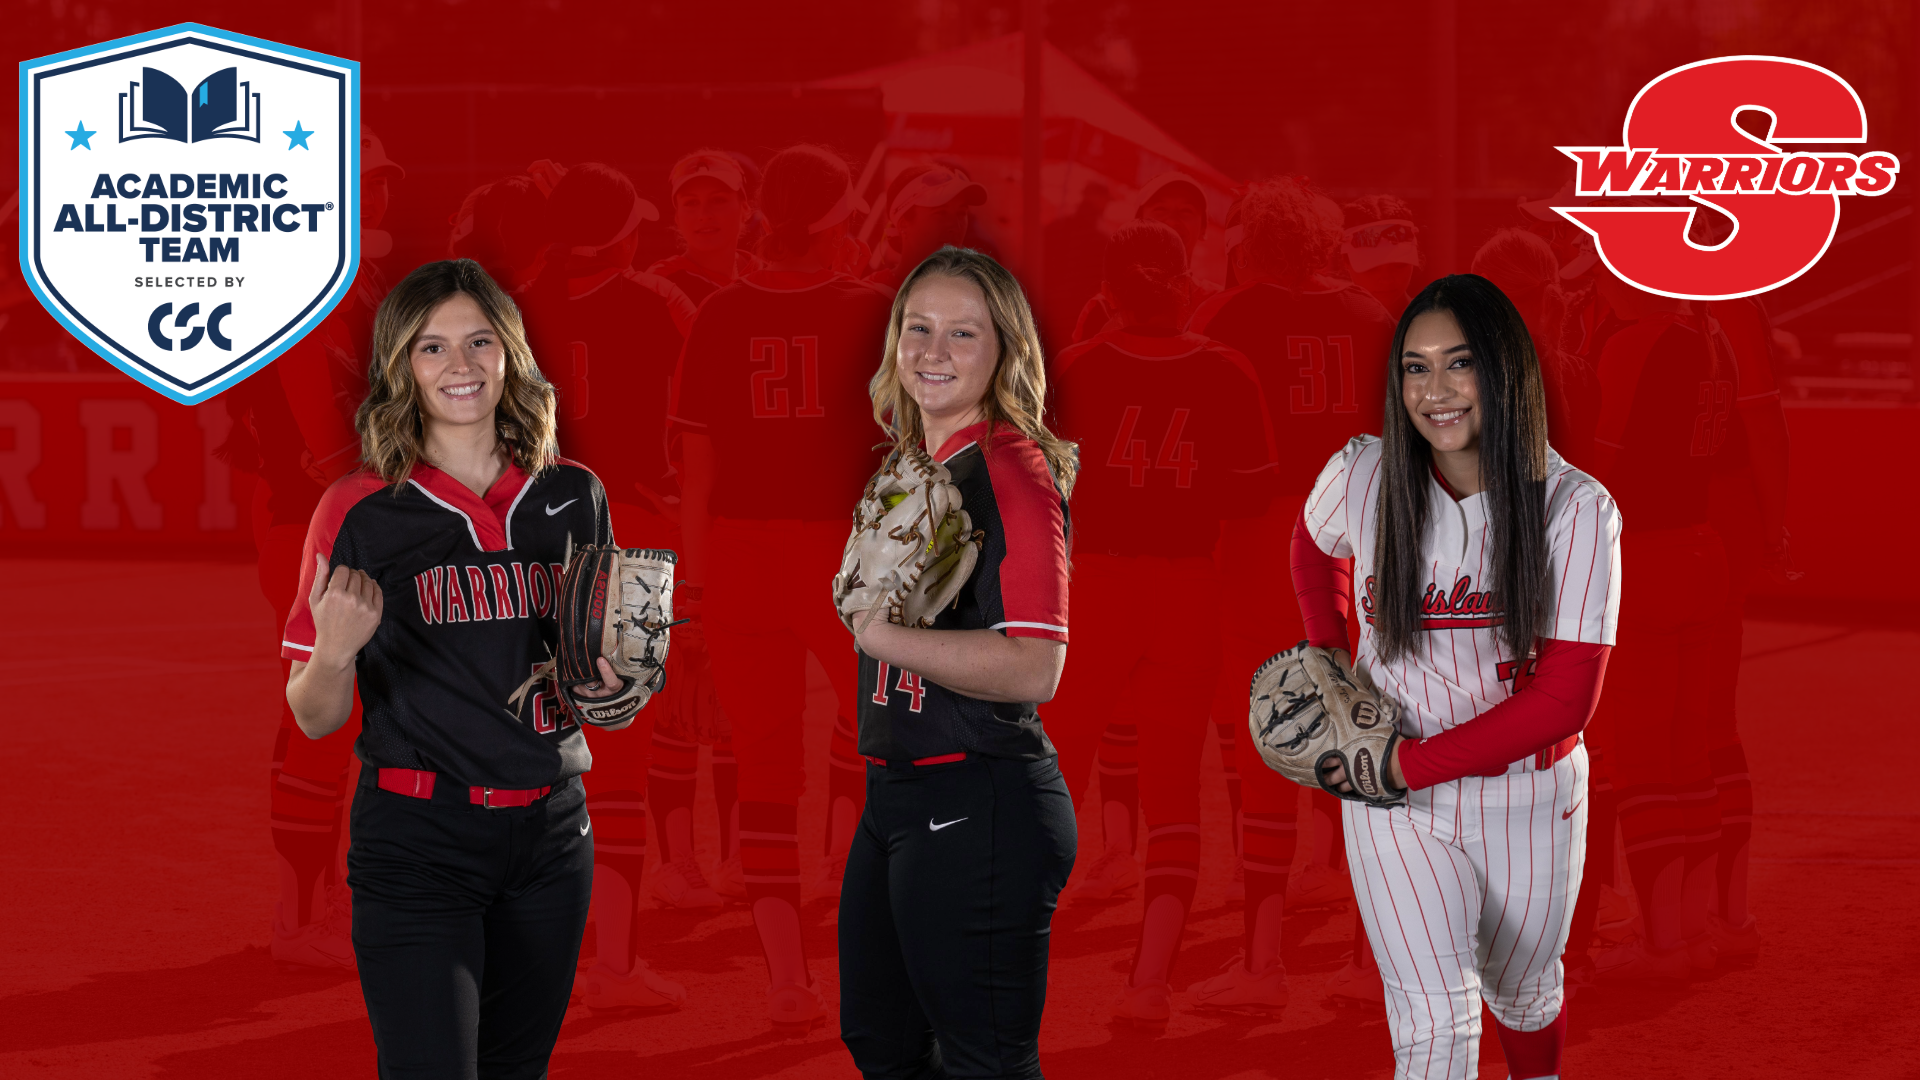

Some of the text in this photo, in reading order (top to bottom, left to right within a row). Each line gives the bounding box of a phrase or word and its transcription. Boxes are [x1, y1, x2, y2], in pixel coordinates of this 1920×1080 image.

[750, 335, 825, 418] 21
[1286, 335, 1359, 414] 31
[1105, 405, 1199, 489] 44
[1690, 380, 1733, 457] 22
[592, 569, 608, 620] A2000
[590, 697, 637, 720] Wilson
[872, 660, 926, 713] 14
[1359, 753, 1376, 794] Wilson
